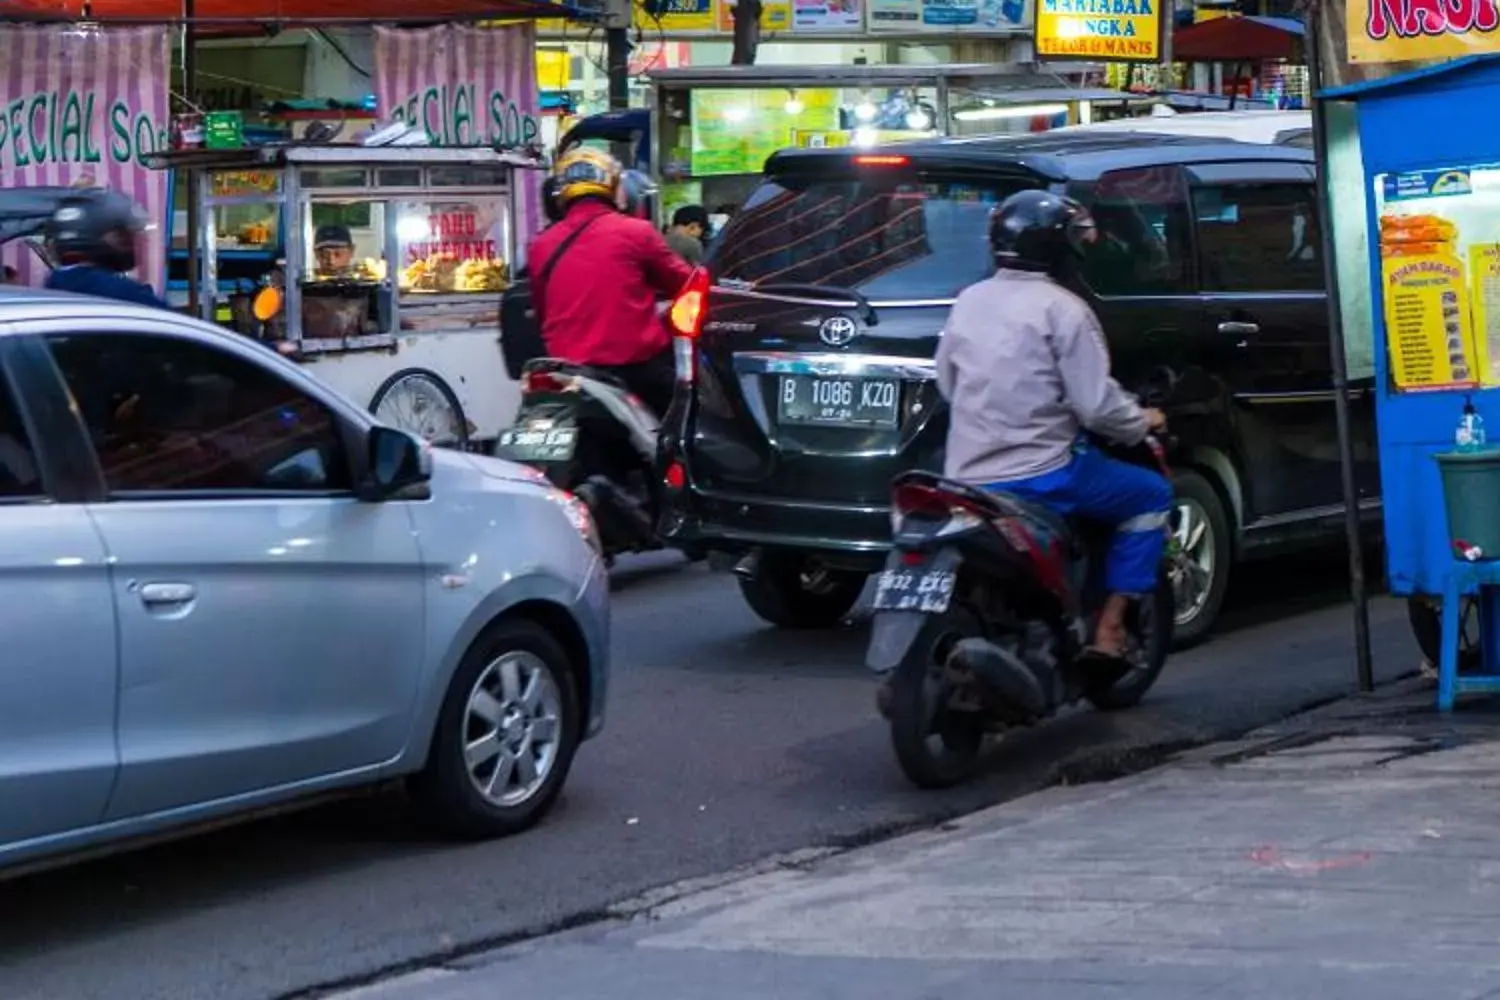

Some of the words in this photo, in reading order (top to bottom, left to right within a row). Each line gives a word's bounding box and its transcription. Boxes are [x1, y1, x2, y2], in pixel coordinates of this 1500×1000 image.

[1064, 18, 1136, 37] NGKA
[783, 379, 796, 403] B
[811, 380, 854, 405] 1086
